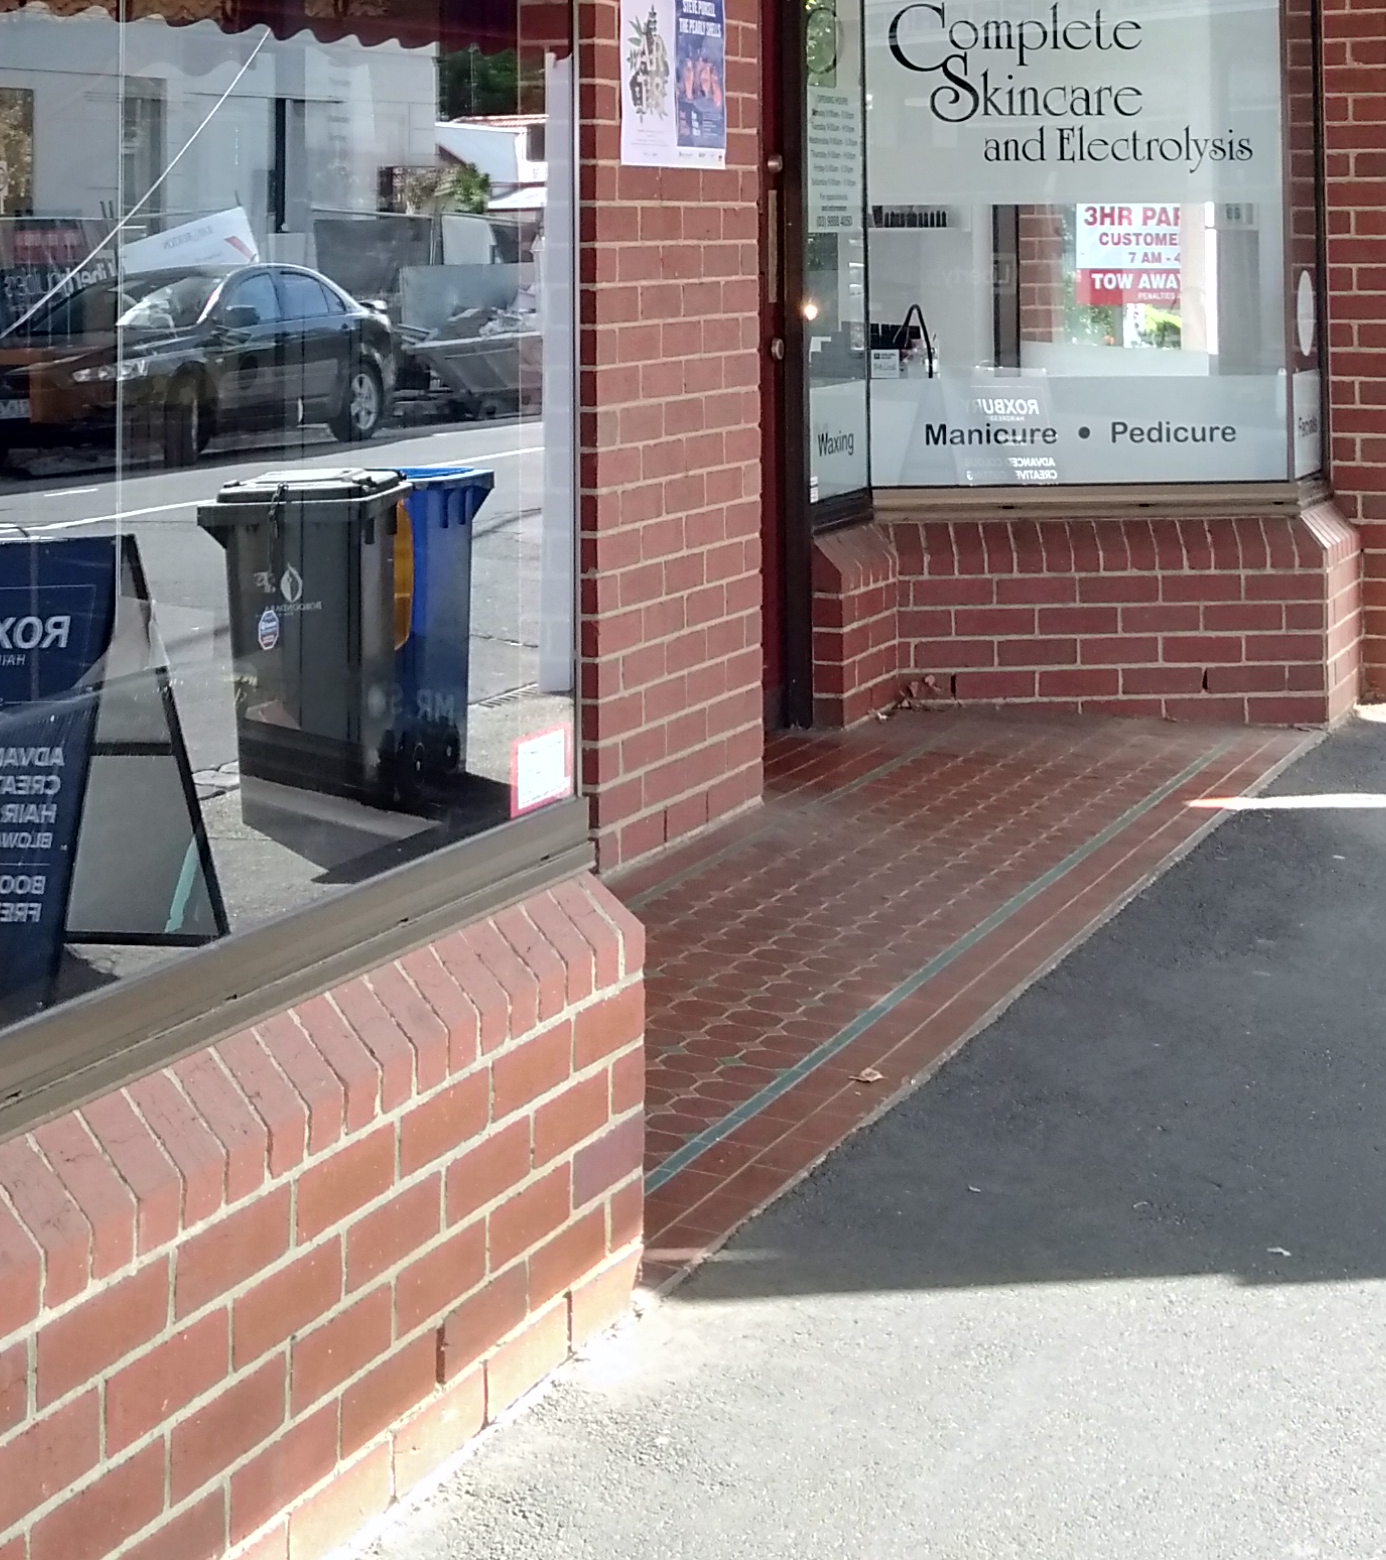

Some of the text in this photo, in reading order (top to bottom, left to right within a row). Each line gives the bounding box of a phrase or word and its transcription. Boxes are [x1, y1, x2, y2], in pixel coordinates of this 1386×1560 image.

[888, 2, 1143, 72] Complete
[929, 51, 1143, 123] Skincare
[983, 125, 1253, 174] and Electrolysis
[1083, 206, 1133, 227] 3HR
[1128, 252, 1136, 263] 7
[1141, 252, 1162, 263] AM
[1091, 273, 1134, 290] TOW
[817, 430, 854, 457] Waxing
[925, 421, 1237, 446] Manicure Pedicure
